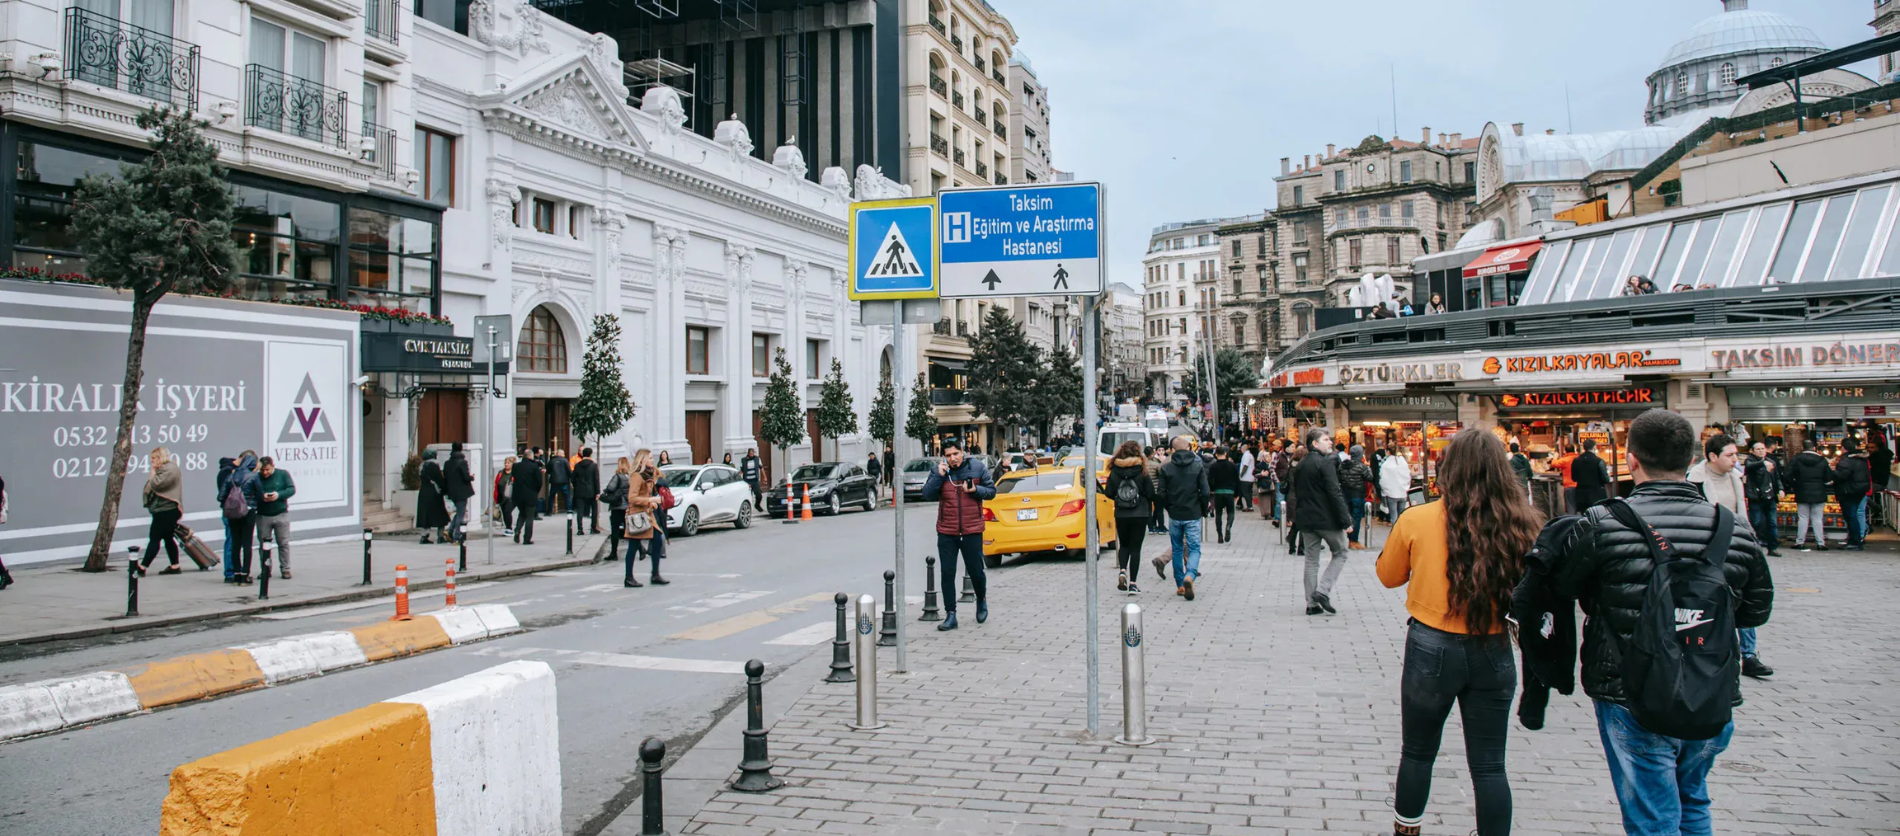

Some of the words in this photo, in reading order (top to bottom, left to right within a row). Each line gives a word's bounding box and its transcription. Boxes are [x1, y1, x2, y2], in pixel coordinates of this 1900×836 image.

[1009, 194, 1053, 213] Taksim
[973, 217, 1013, 239] Eğitim
[1015, 220, 1030, 234] ve
[1033, 215, 1094, 236] Araştırma
[1003, 238, 1062, 256] Hastanesi
[1506, 351, 1643, 373] KIZILKAYALAR
[1643, 358, 1680, 367] HAMBURGER
[1712, 345, 1803, 369] TAKSİM
[1339, 362, 1463, 383] ÖZTÜRKLER
[155, 377, 247, 419] İŞYERİ
[53, 426, 107, 447] 0532
[157, 424, 181, 444] 50
[186, 423, 208, 443] 49
[53, 456, 107, 479] 0212
[185, 452, 208, 472] 88
[275, 446, 338, 462] VERSATIE
